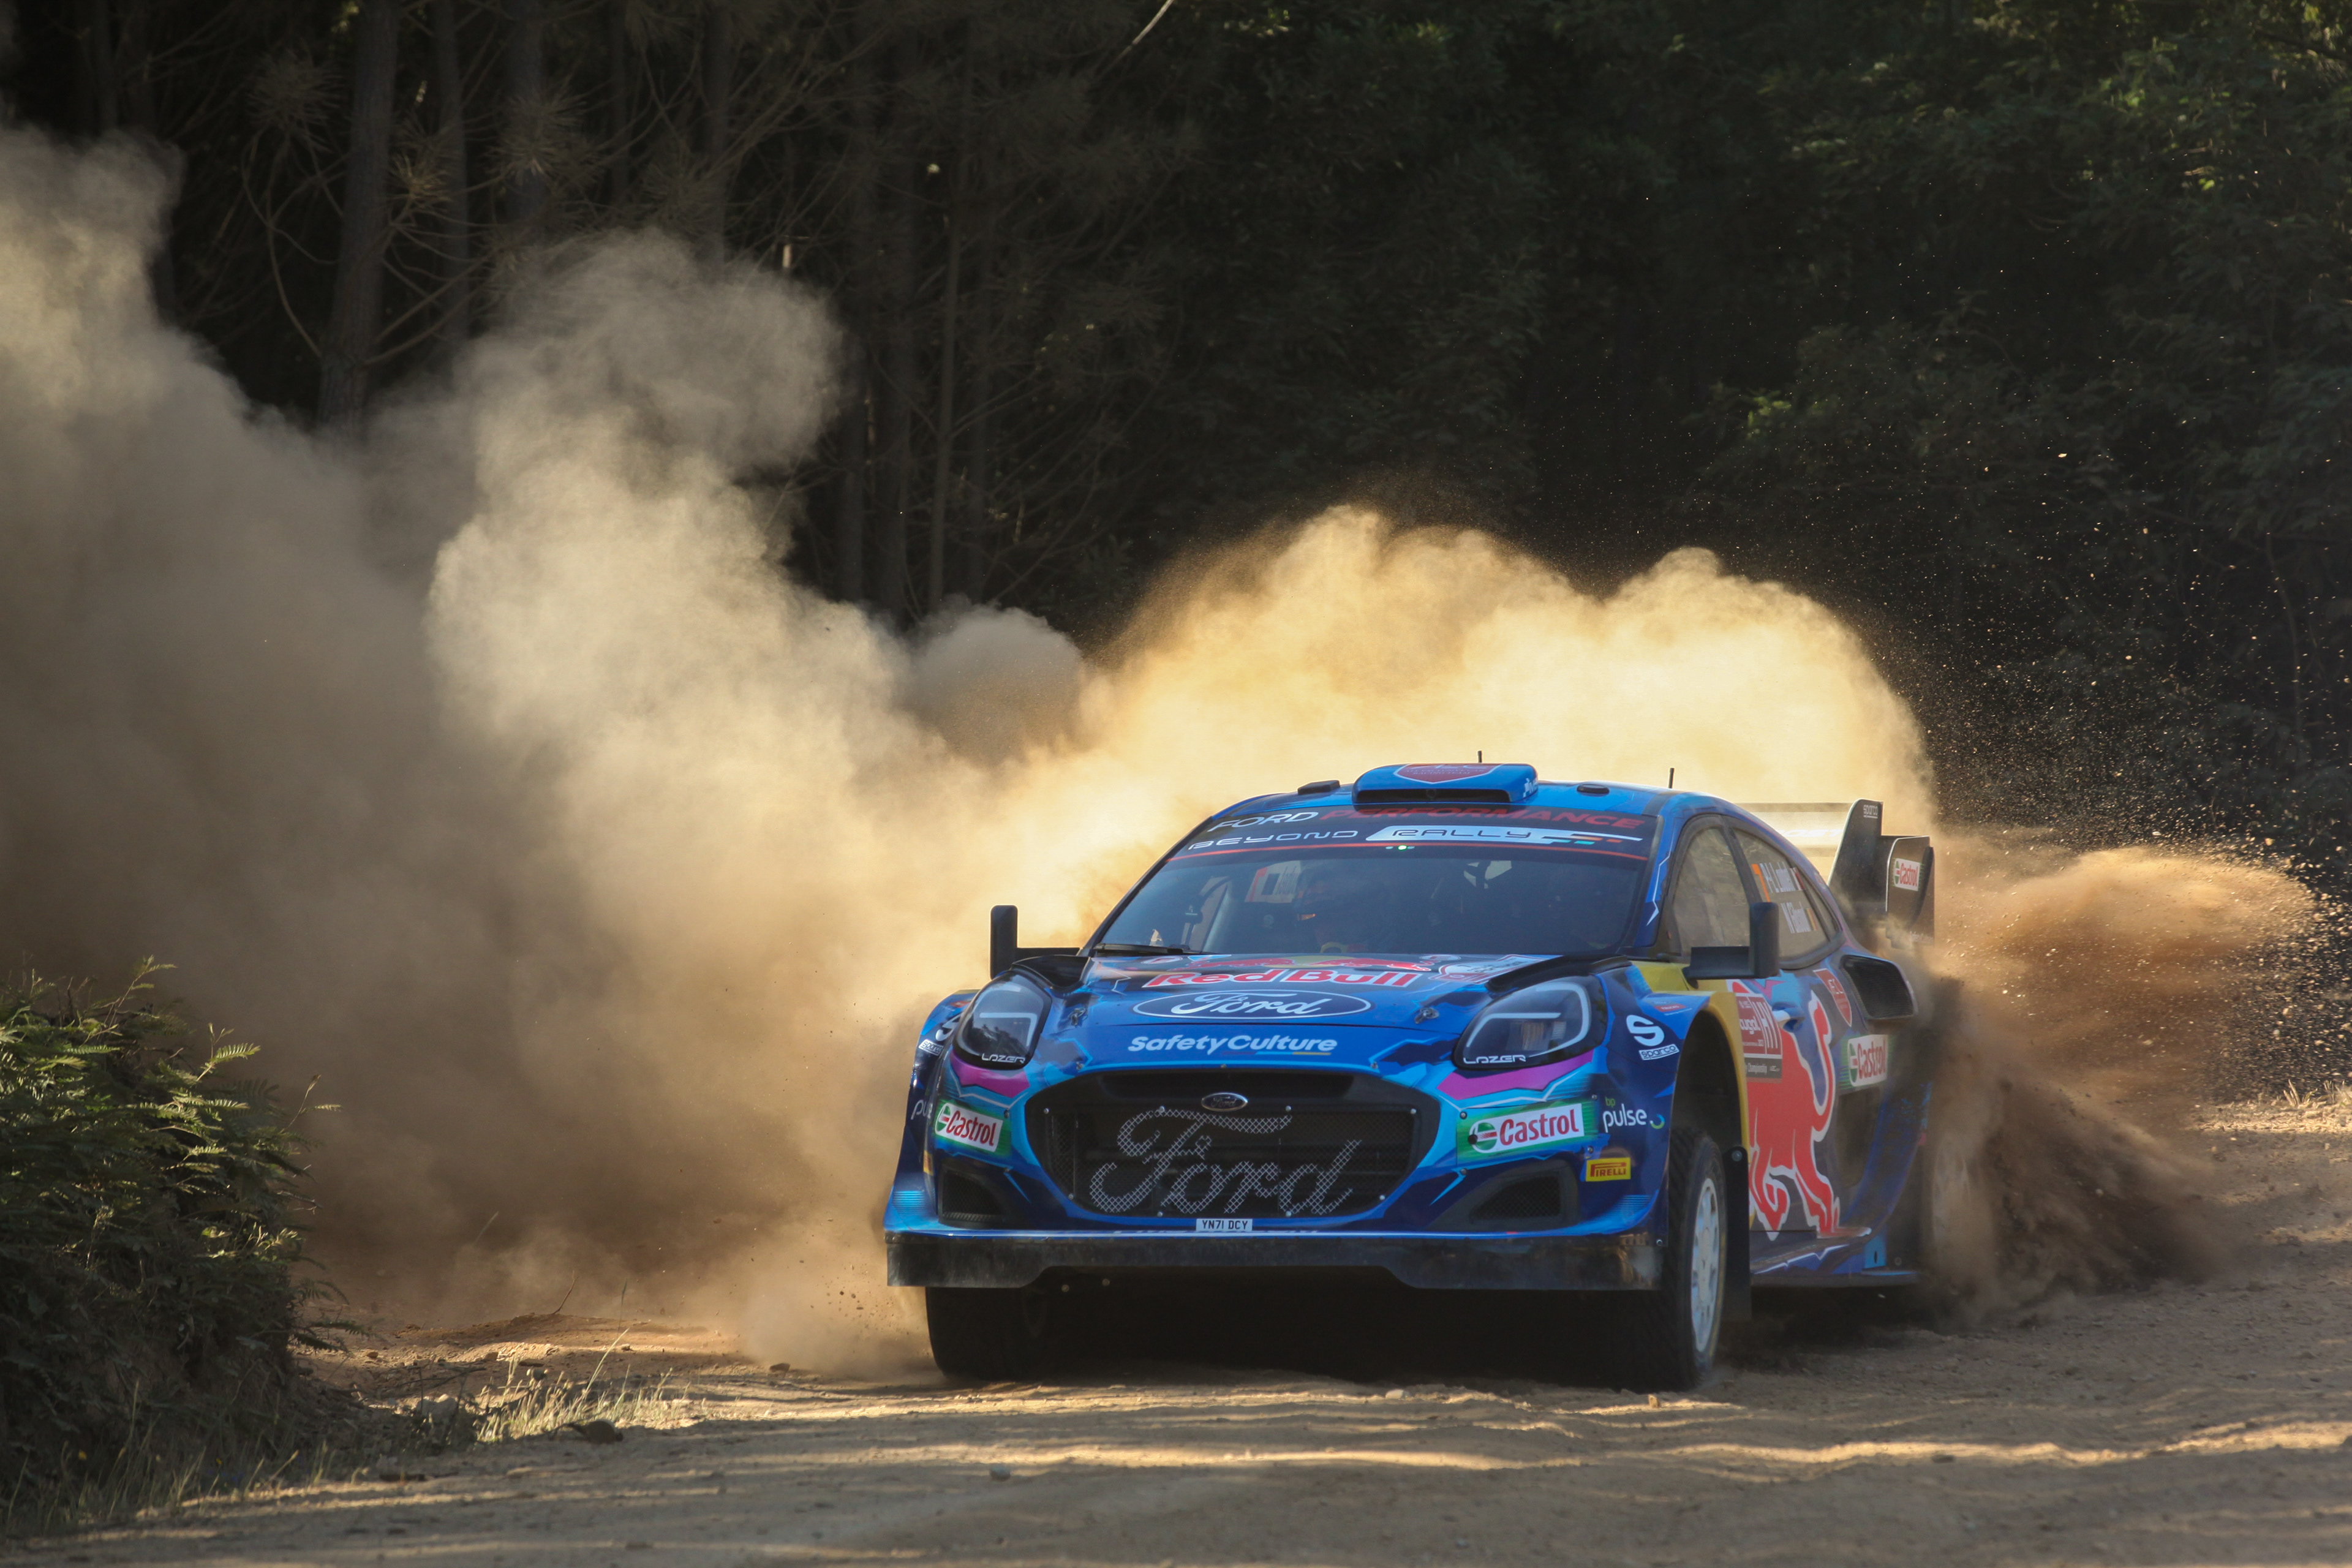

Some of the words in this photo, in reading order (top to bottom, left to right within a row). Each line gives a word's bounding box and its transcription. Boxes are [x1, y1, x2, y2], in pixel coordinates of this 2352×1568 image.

[1207, 812, 1319, 832] FORD
[1320, 807, 1645, 829] PERFORMANCE
[1863, 805, 1879, 816] sparco
[1188, 831, 1358, 850] BEYOND
[1392, 829, 1531, 838] RALLY
[1899, 863, 1918, 887] Castrol
[1143, 969, 1288, 987] Red
[1281, 969, 1421, 987] Bull
[1170, 993, 1332, 1014] Ford
[1128, 1035, 1338, 1055] SafetyCulture
[1642, 1045, 1676, 1060] sparco
[981, 1053, 1025, 1064] LAZER
[1463, 1055, 1526, 1065] LAZER
[1857, 1039, 1887, 1079] Castrol
[1210, 1096, 1237, 1107] Ford
[1605, 1096, 1616, 1108] bp
[1501, 1109, 1579, 1146] Castrol
[1602, 1103, 1648, 1133] pulse
[946, 1110, 997, 1147] Castrol
[1090, 1109, 1362, 1215] Ford
[1590, 1162, 1627, 1177] PIRELLI
[1202, 1219, 1224, 1229] YN71
[1227, 1219, 1248, 1230] DCY
